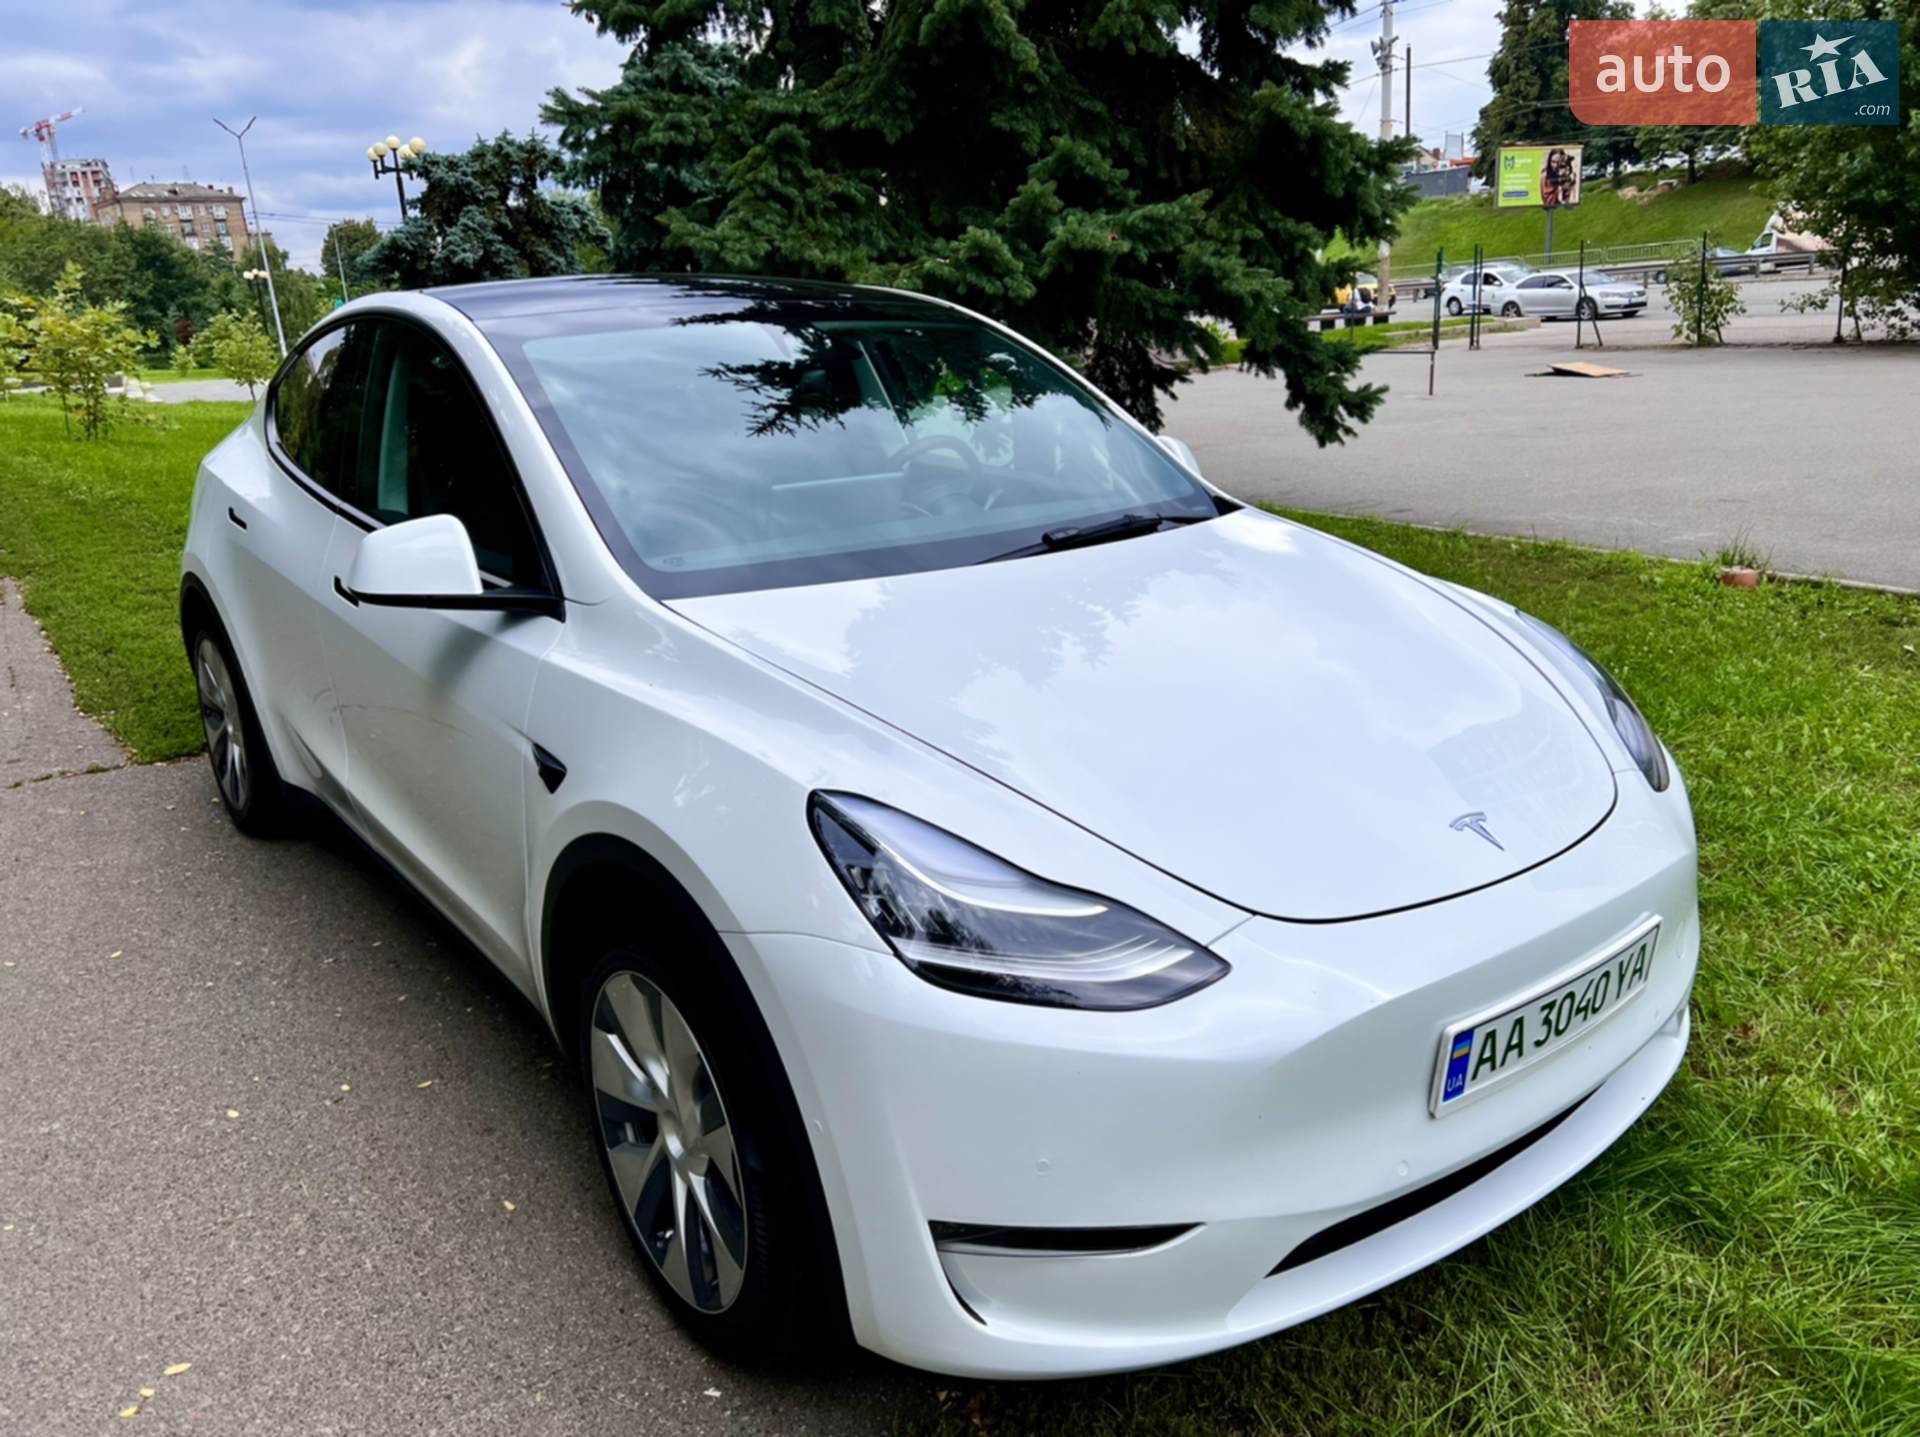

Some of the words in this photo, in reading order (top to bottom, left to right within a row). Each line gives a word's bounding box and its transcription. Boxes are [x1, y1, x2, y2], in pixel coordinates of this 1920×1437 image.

[1470, 1015, 1525, 1082] AA
[1533, 969, 1611, 1048] 3040
[1615, 942, 1648, 1000] YA
[1446, 1073, 1463, 1092] UA
